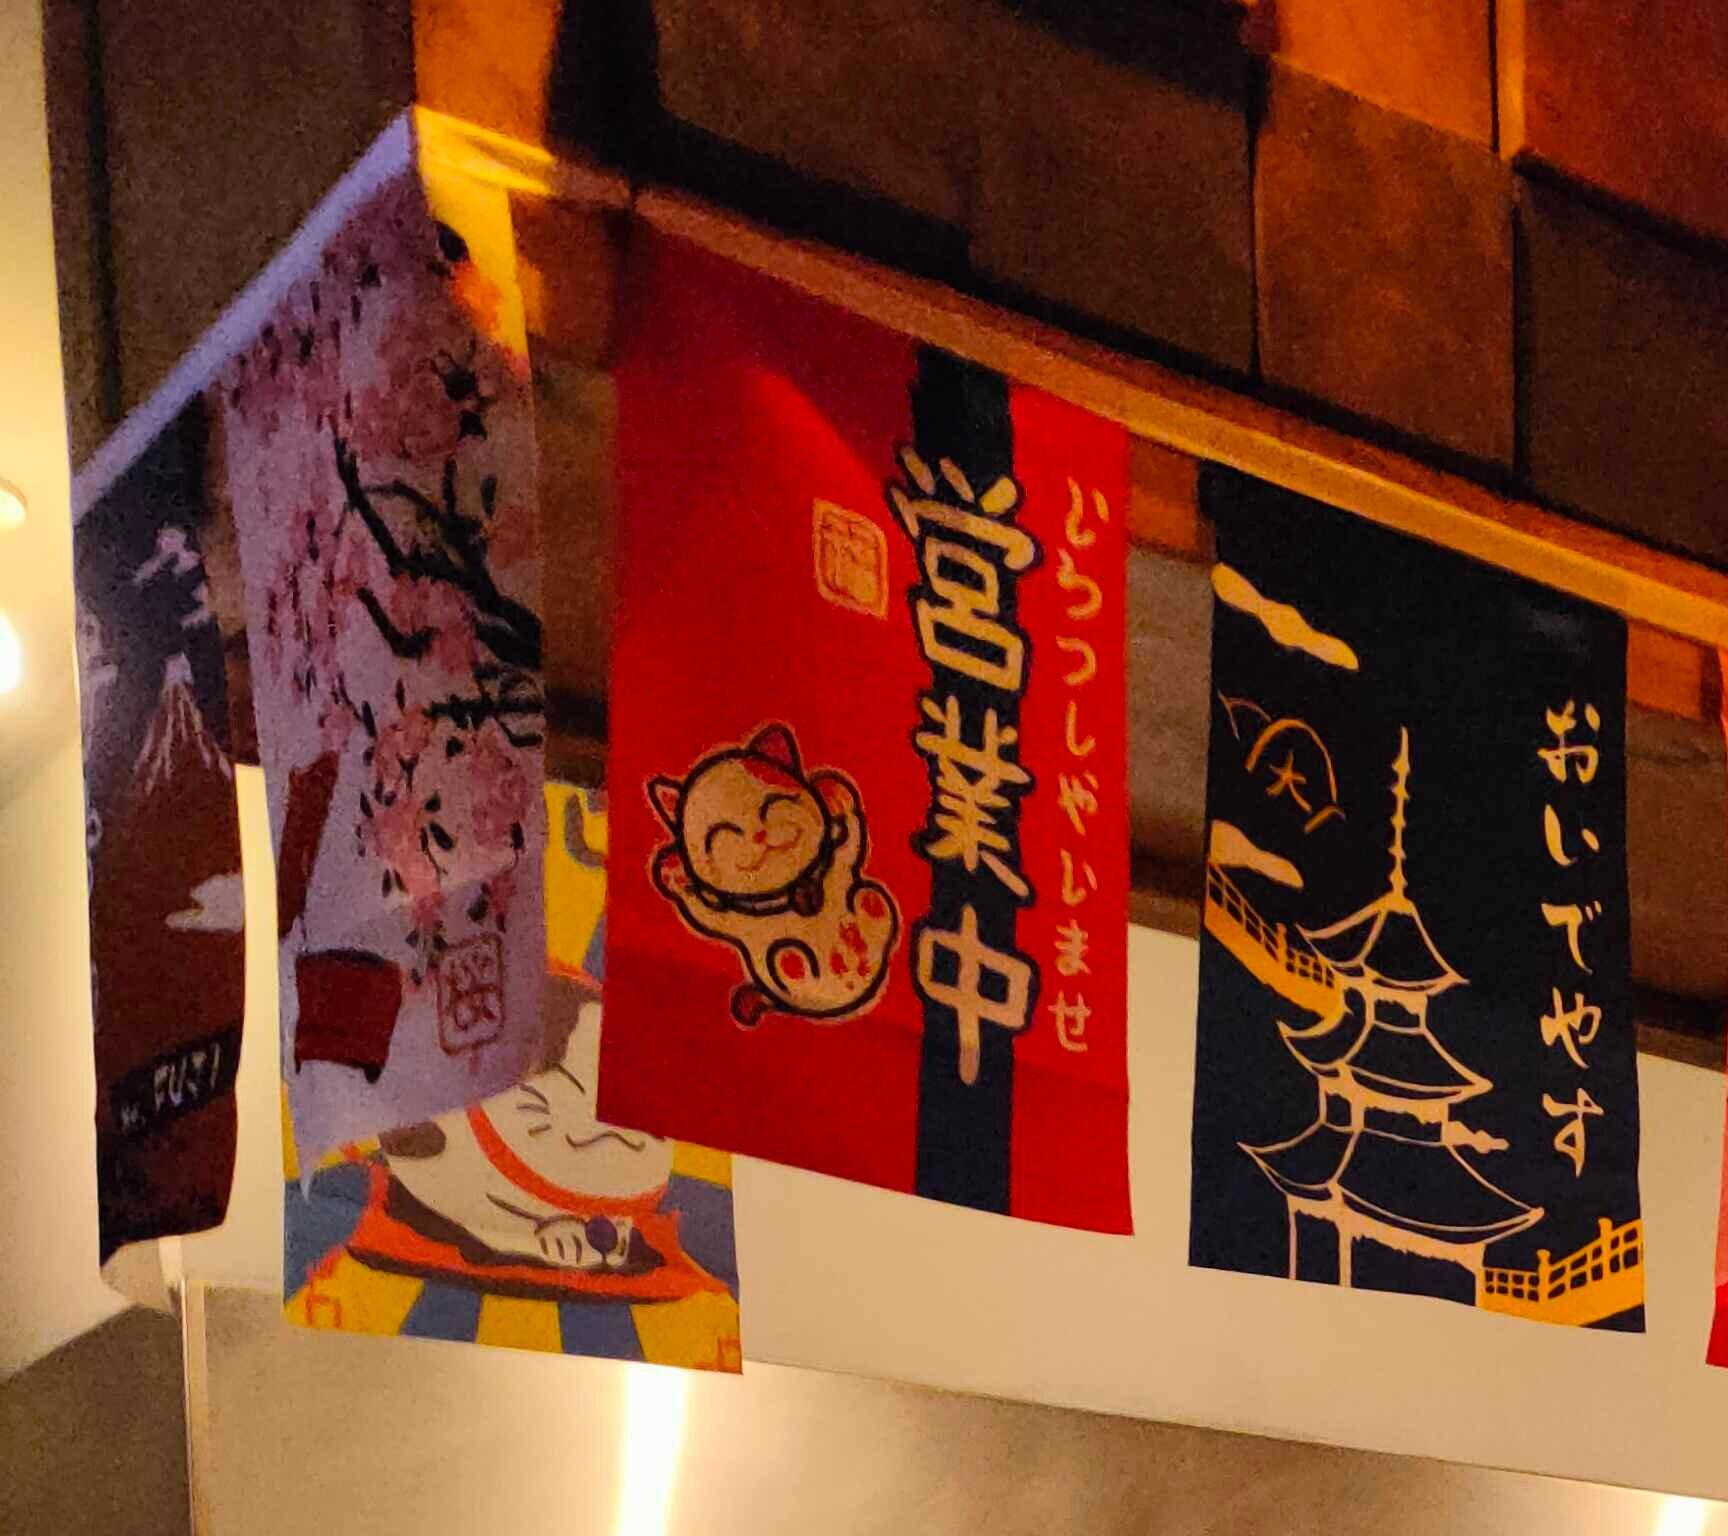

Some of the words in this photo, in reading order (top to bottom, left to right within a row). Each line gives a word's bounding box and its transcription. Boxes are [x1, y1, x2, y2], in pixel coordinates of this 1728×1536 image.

[895, 446, 1036, 1085] 営業中
[1537, 699, 1606, 1180] おいでやす
[153, 1042, 220, 1113] FUJI
